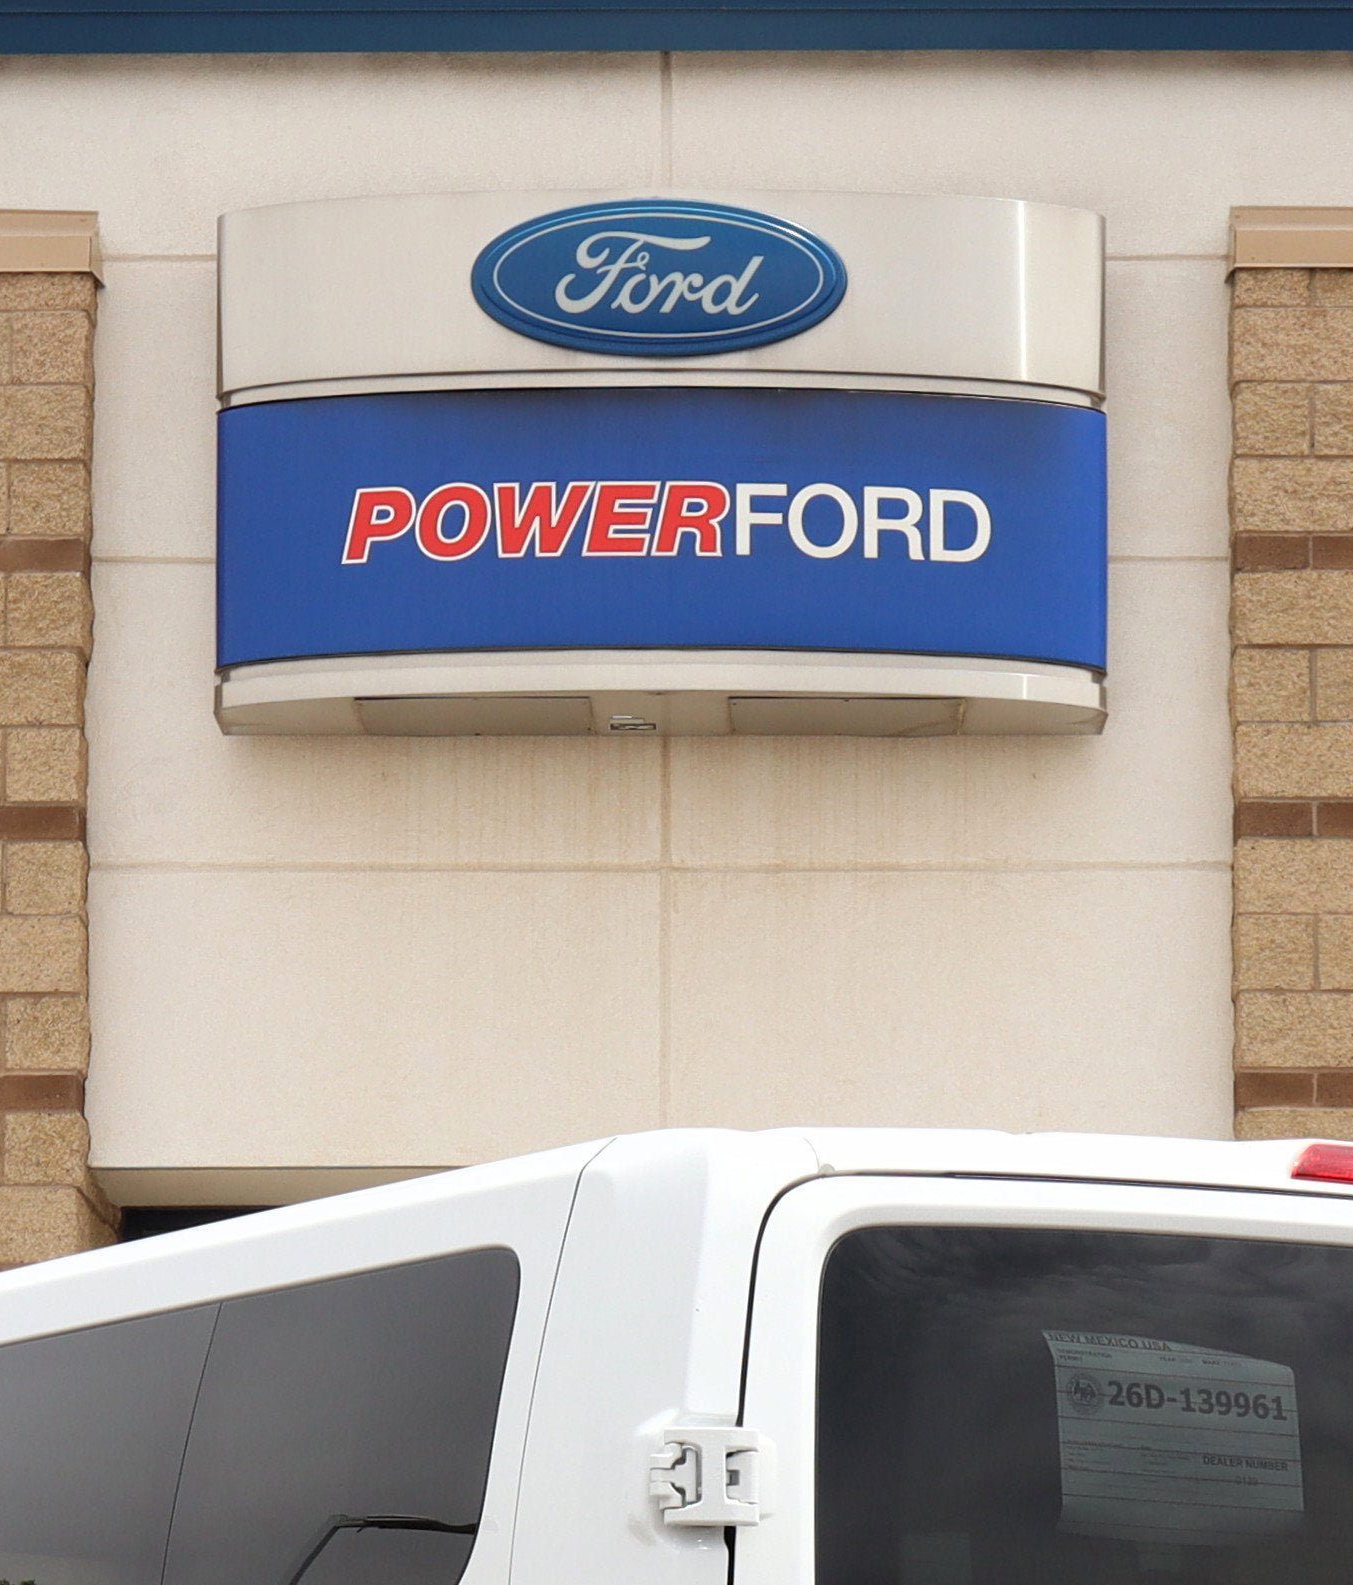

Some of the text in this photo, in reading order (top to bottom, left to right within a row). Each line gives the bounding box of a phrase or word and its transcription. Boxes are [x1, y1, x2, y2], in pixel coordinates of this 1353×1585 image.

[555, 230, 764, 316] Ford
[341, 480, 992, 565] POWERFORD
[1049, 1333, 1172, 1351] NEW MEXICO USA
[1107, 1380, 1288, 1421] 26D-139961
[1203, 1455, 1289, 1471] DEALER NUMBER
